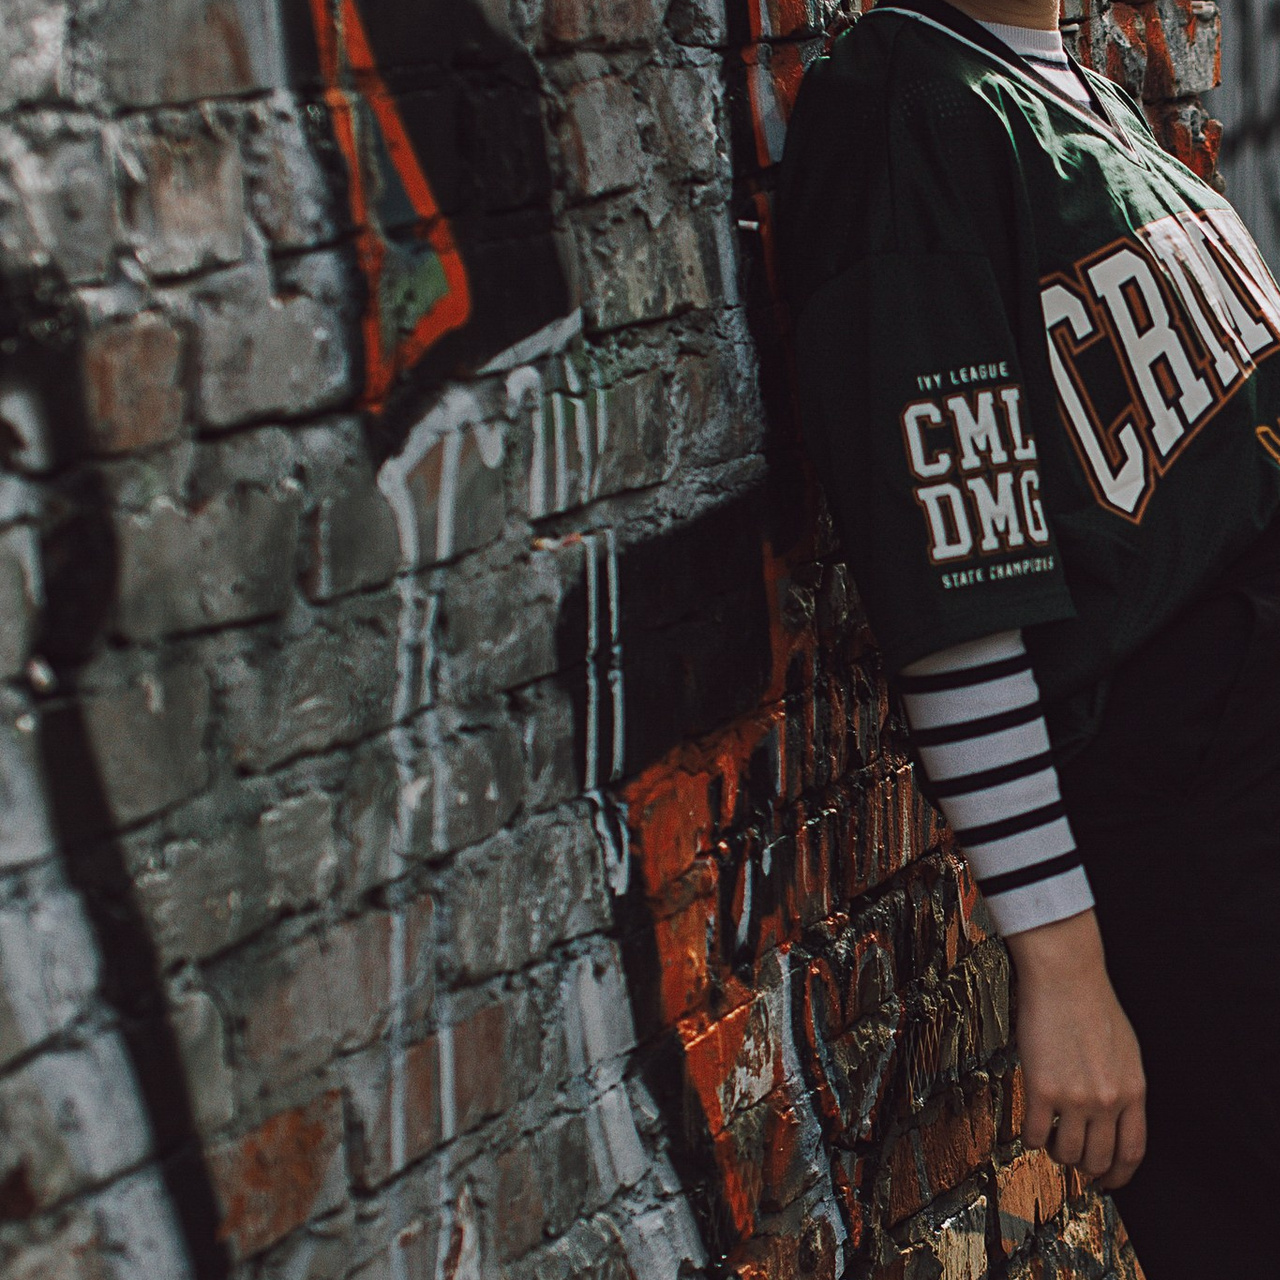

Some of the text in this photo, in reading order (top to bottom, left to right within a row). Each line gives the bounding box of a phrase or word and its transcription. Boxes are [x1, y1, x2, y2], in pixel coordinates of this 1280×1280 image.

[917, 361, 1010, 391] IVY LEAGUE
[903, 387, 1037, 478] CML
[916, 469, 1049, 561] DMG
[941, 568, 984, 589] STATE
